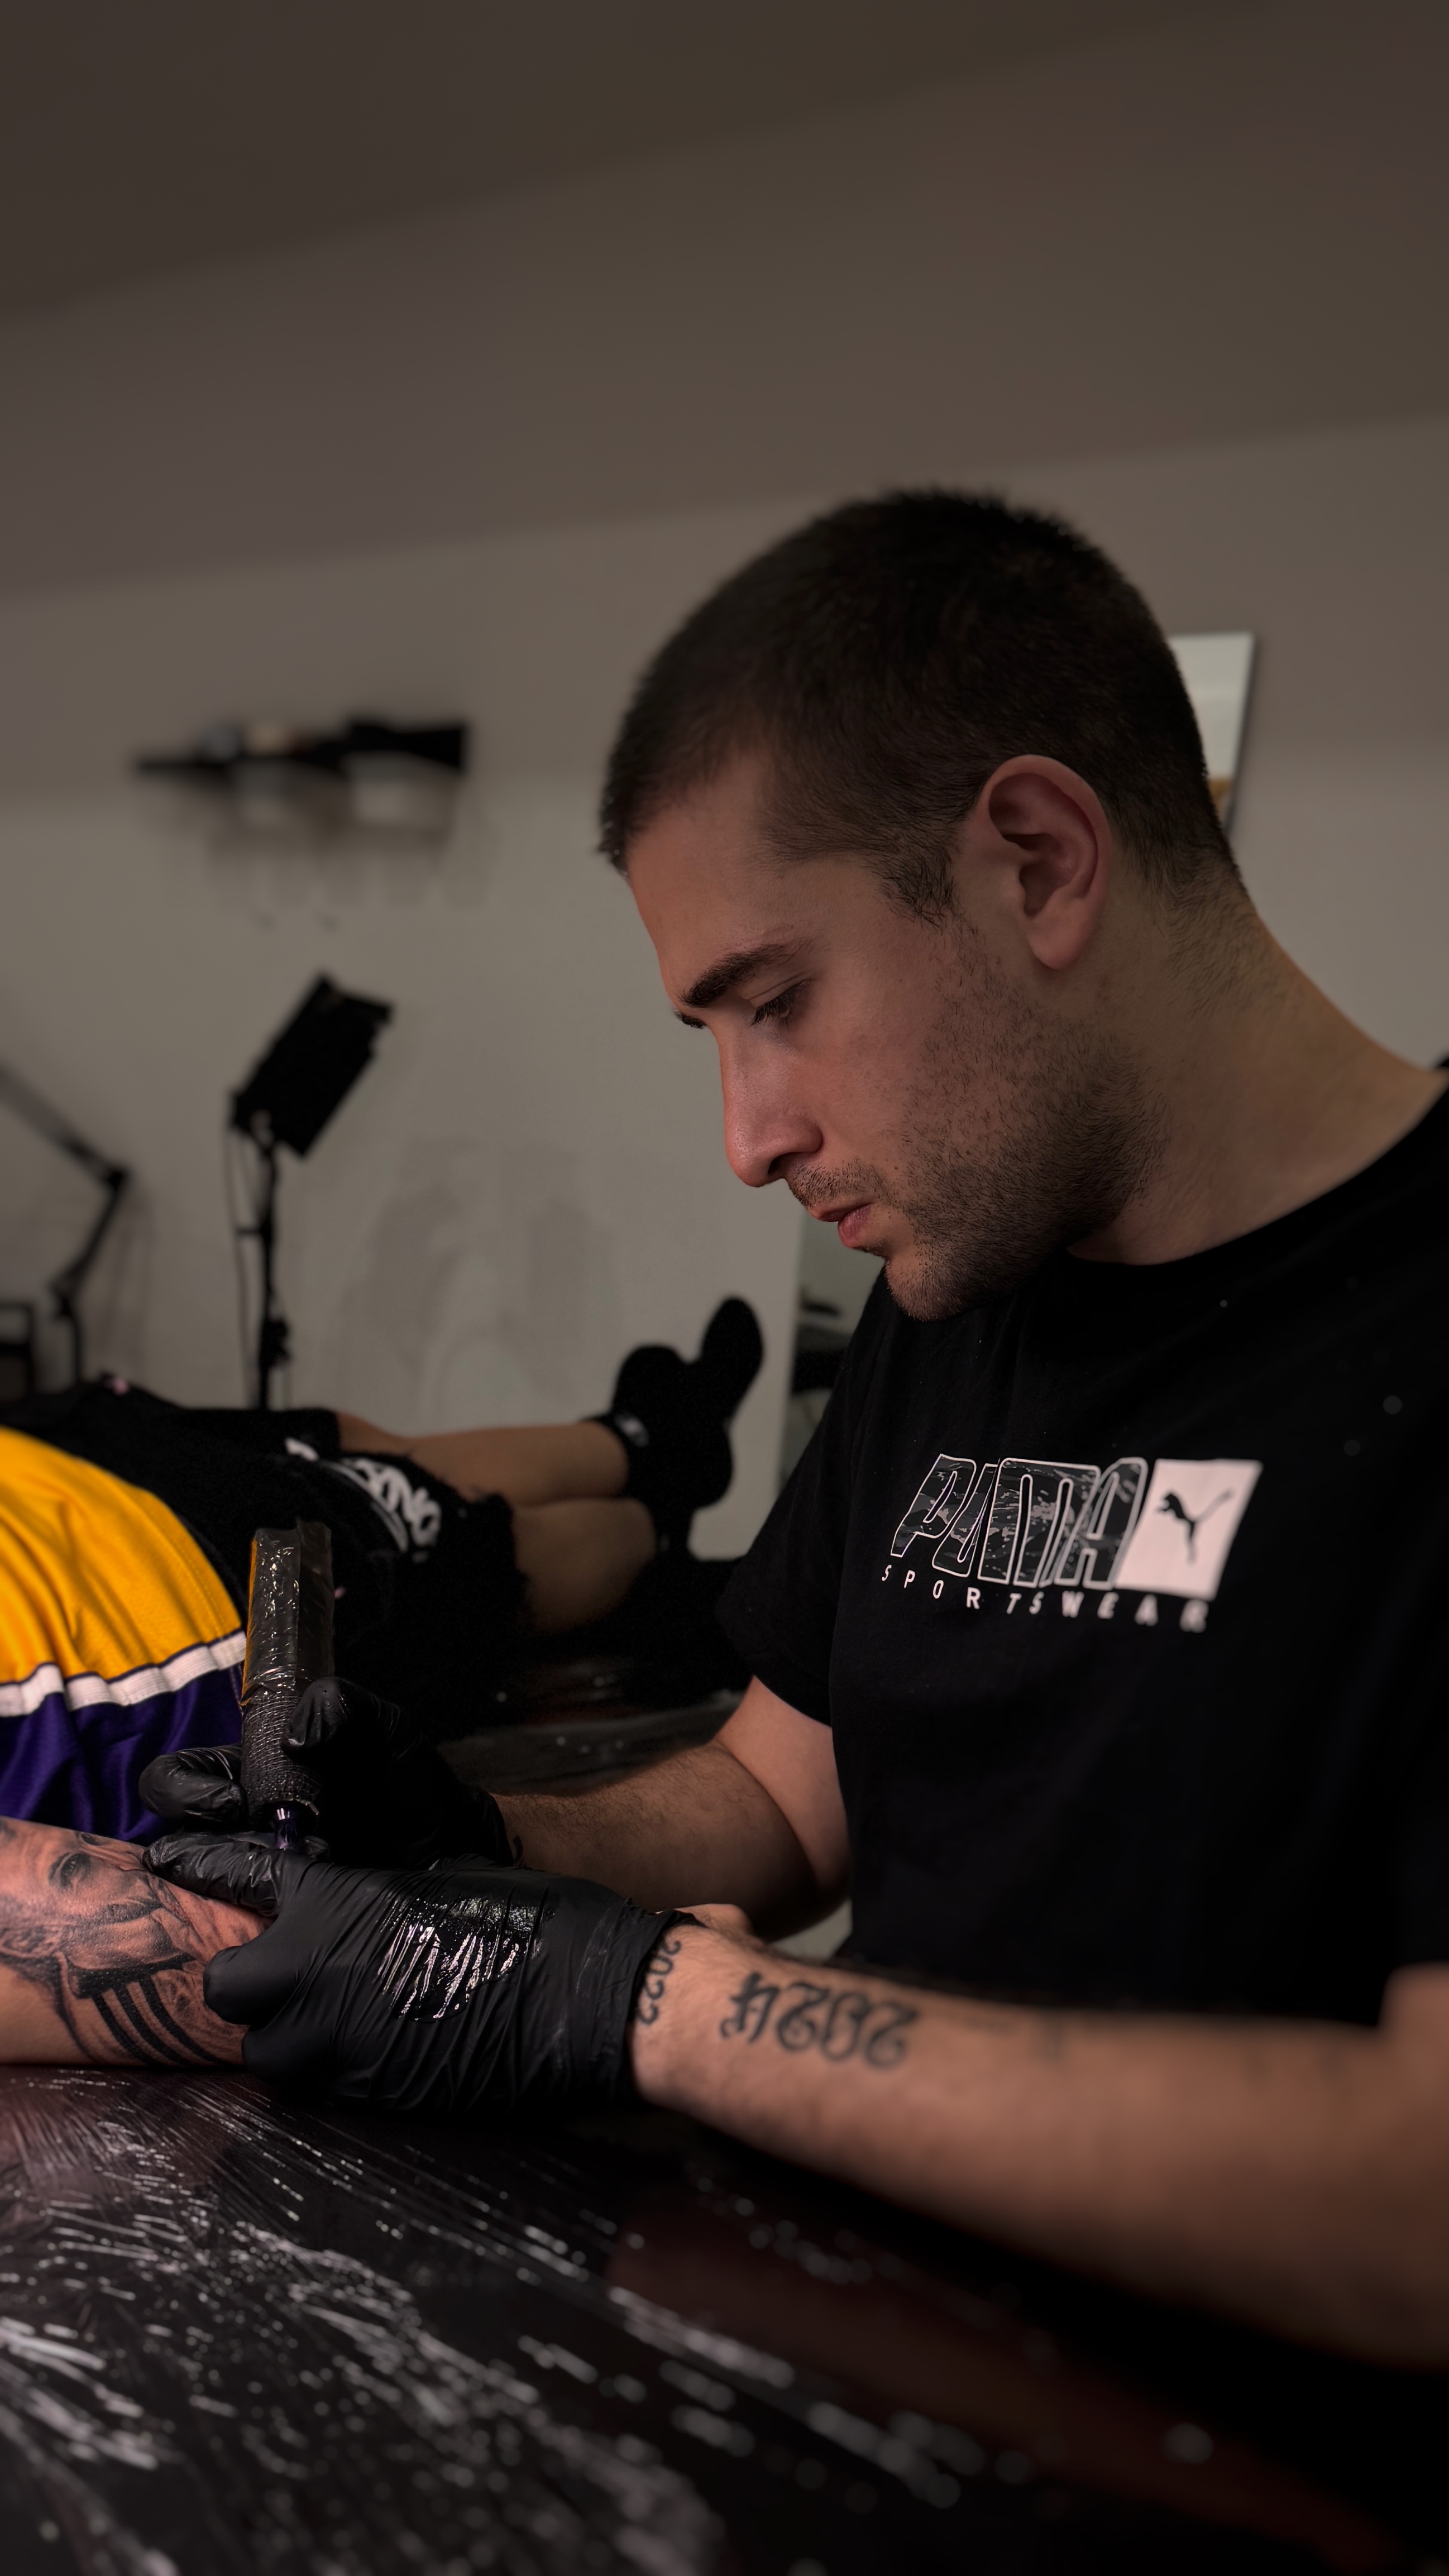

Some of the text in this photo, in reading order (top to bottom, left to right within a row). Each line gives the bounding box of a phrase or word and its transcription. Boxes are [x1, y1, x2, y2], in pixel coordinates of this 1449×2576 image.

[891, 1453, 1148, 1588] PUMA
[881, 1564, 1209, 1633] SPORTSWEAR
[719, 1971, 920, 2071] 2024
